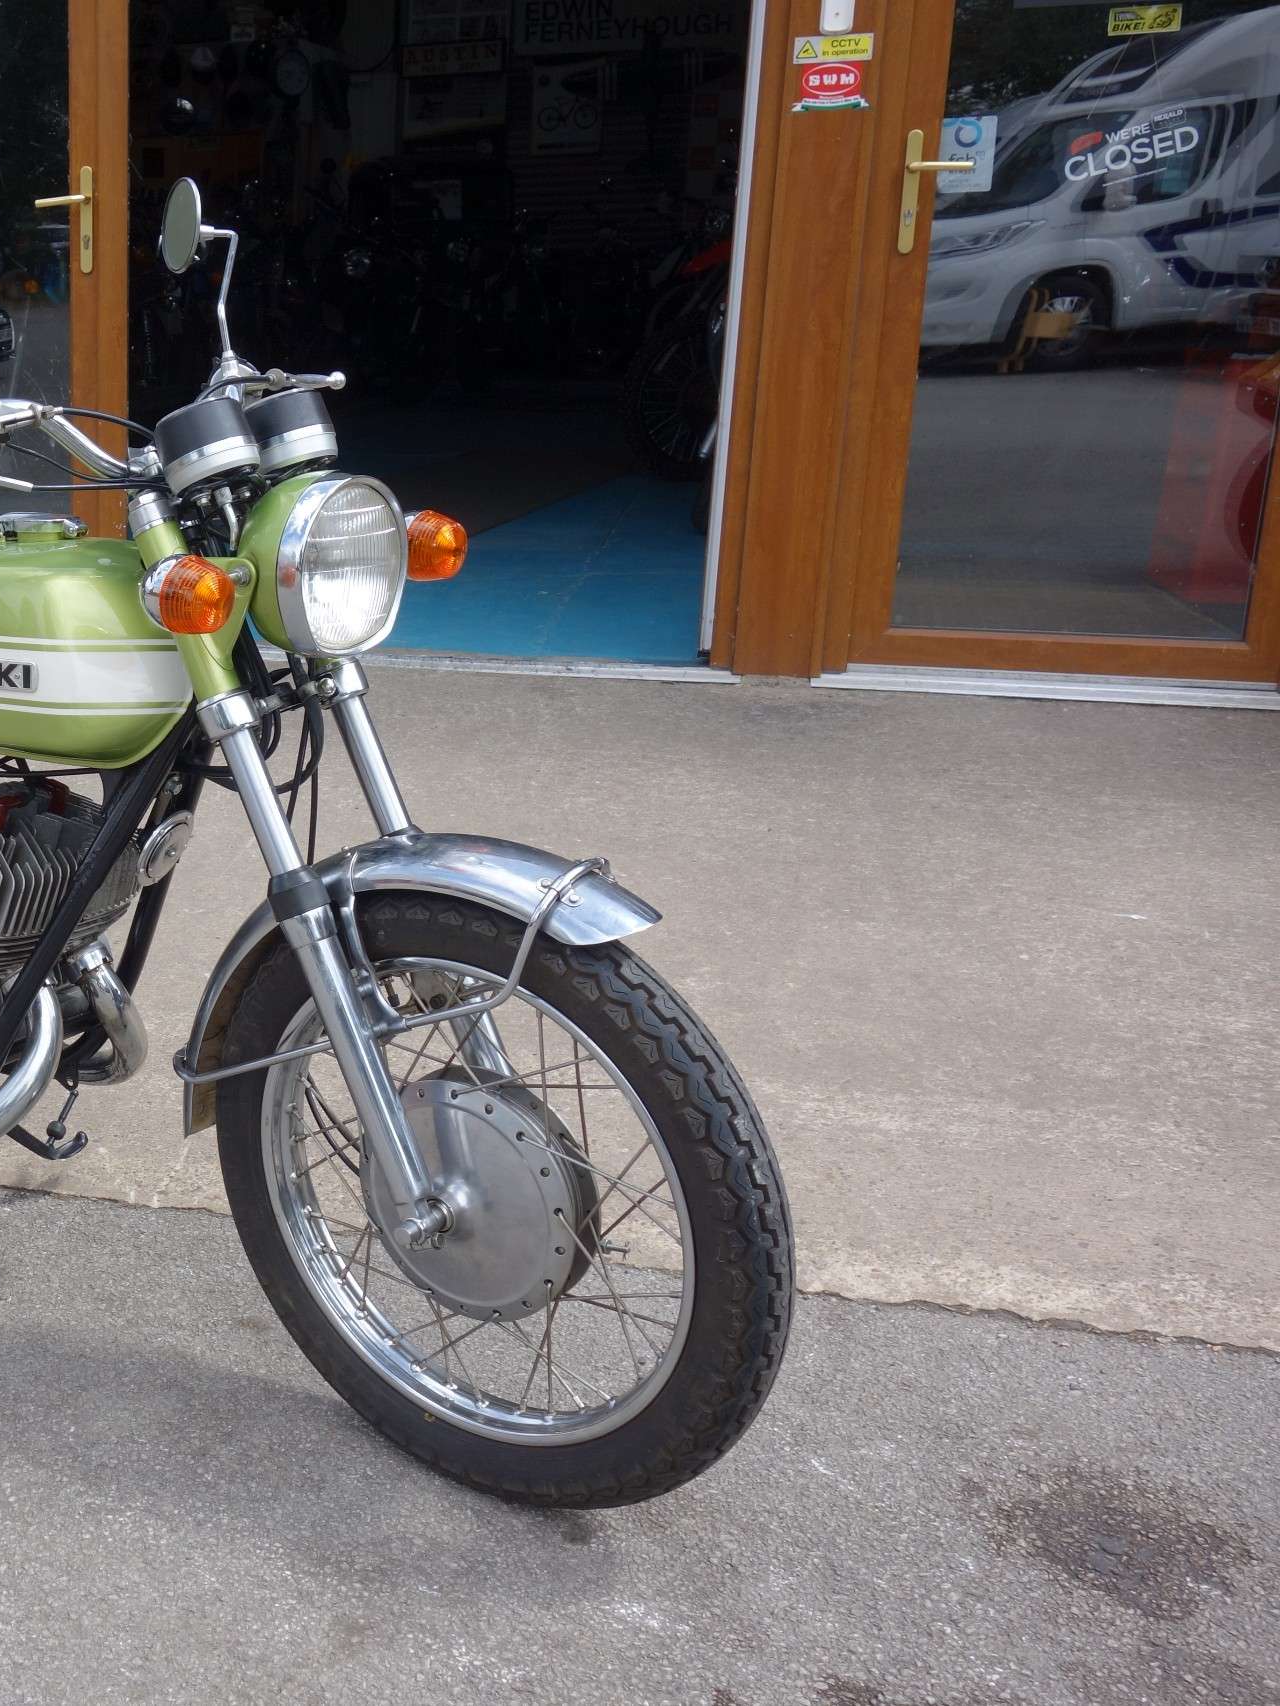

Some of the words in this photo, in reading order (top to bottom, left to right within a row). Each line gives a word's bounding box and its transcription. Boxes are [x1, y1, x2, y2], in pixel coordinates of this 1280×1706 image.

[525, 0, 613, 21] EDWIN
[831, 38, 861, 48] CCTV
[831, 48, 869, 56] operation
[808, 73, 855, 87] SWM
[1105, 122, 1151, 144] WE'RE
[1064, 126, 1200, 182] CLOSED
